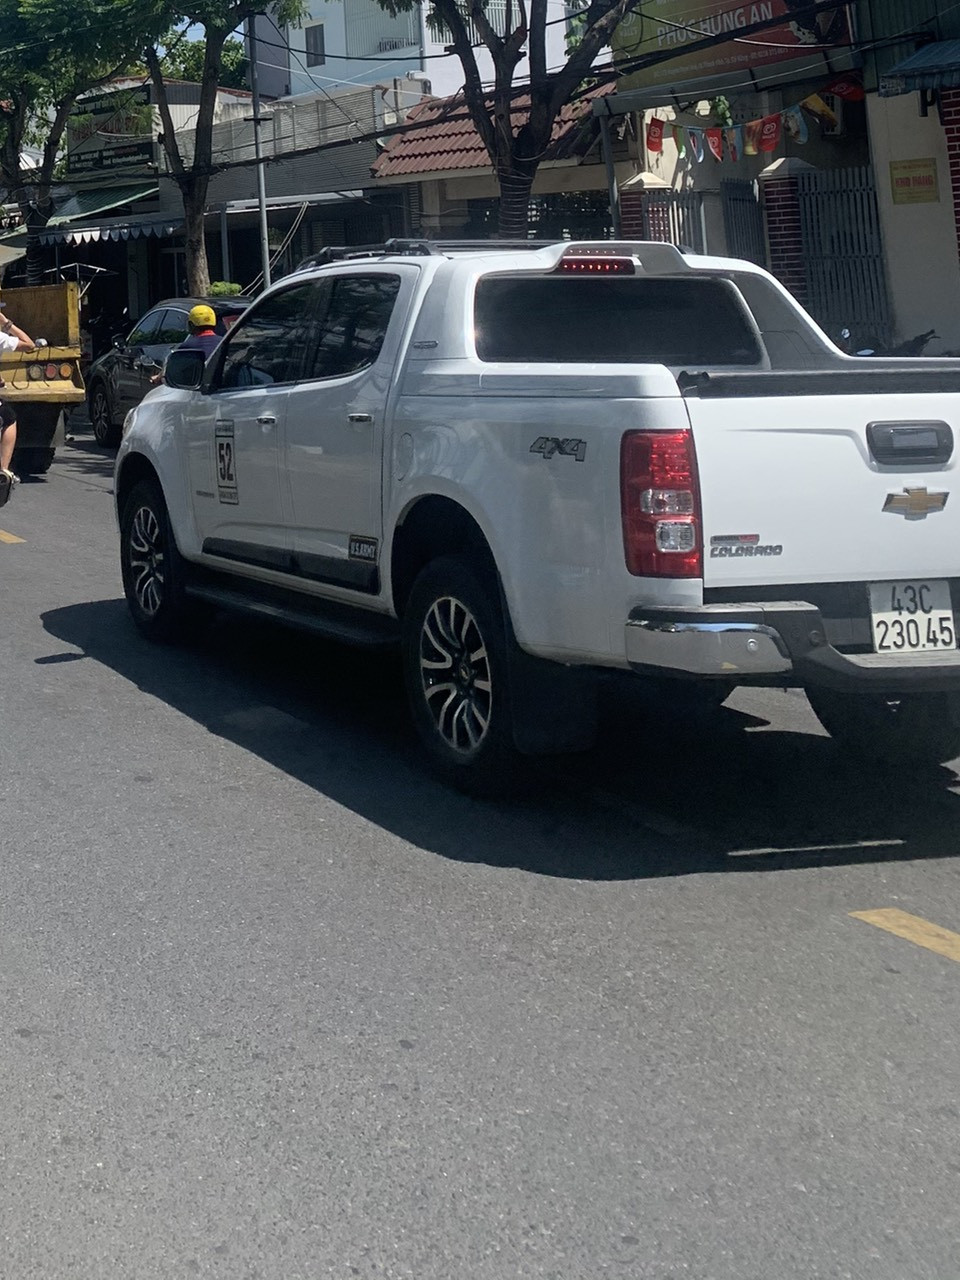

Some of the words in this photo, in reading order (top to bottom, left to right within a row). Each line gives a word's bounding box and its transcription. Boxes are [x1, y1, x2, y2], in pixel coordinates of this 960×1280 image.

[656, 17, 697, 47] PHÚC
[747, 1, 773, 25] AN
[218, 442, 234, 481] 52
[710, 545, 783, 558] COLORADO
[891, 583, 933, 616] 43C
[876, 616, 954, 651] 230.45
